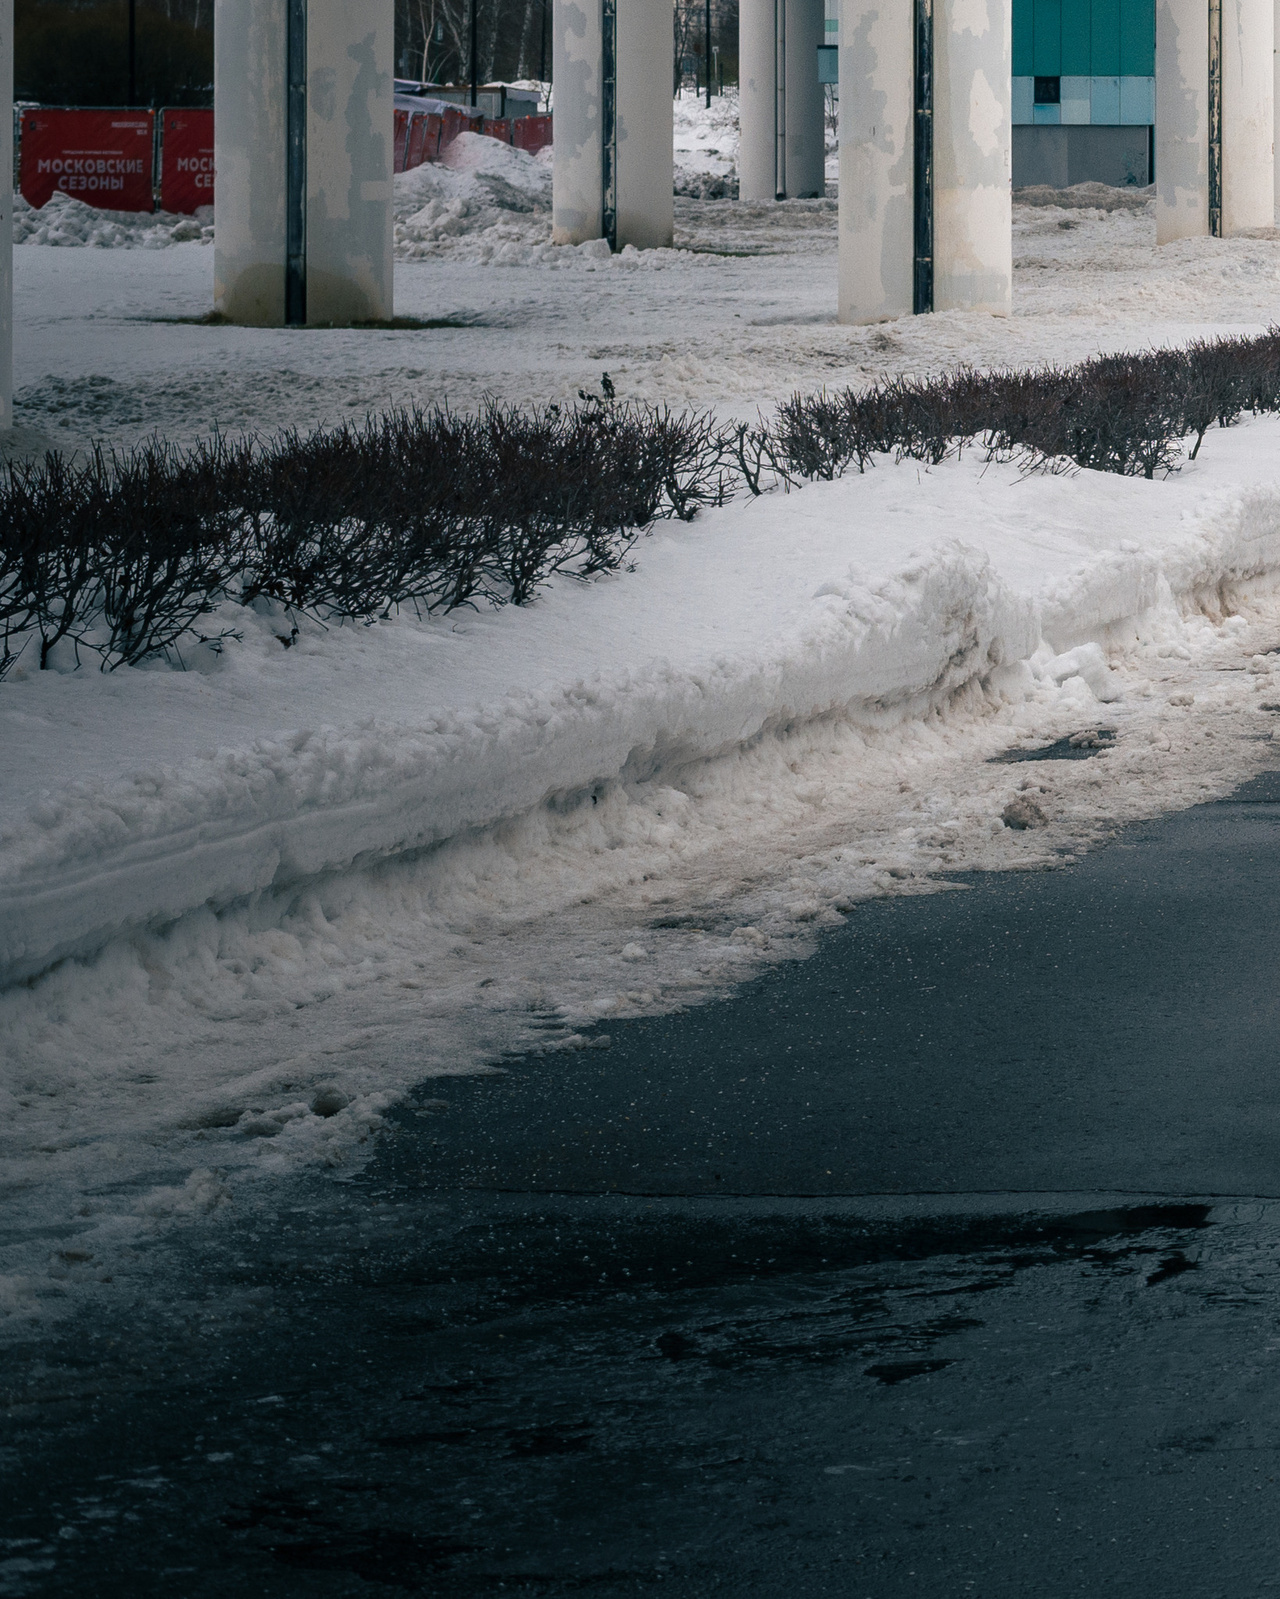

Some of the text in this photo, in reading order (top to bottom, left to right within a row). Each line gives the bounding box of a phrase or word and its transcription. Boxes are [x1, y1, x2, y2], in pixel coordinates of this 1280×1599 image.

[38, 159, 143, 174] МОСКОВСКИЕ
[58, 176, 124, 190] СЕЗОНЫ
[195, 174, 215, 188] СЕ
